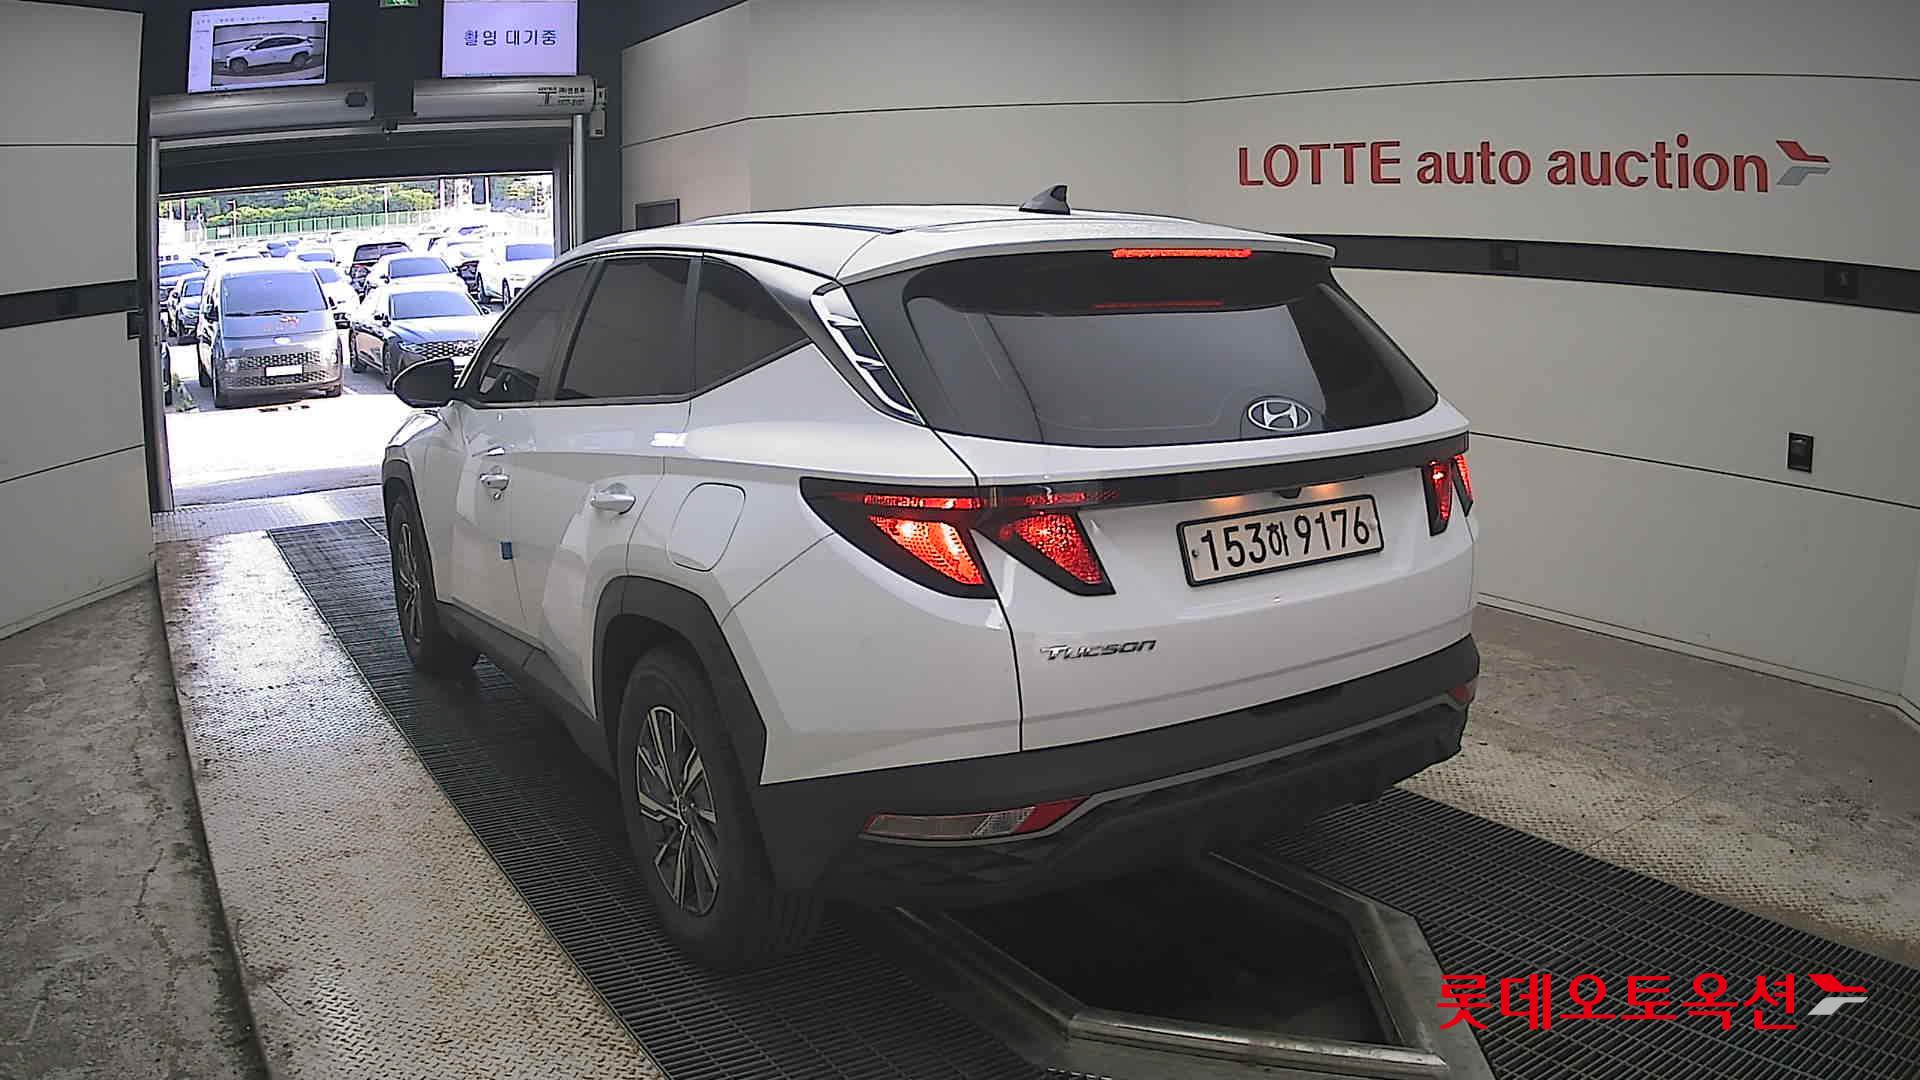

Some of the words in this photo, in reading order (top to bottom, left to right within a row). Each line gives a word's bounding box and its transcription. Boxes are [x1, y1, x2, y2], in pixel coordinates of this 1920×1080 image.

[505, 29, 557, 46] 대기중
[1239, 140, 1400, 188] LOTTE
[1417, 141, 1532, 186] auto
[1547, 133, 1770, 192] auction
